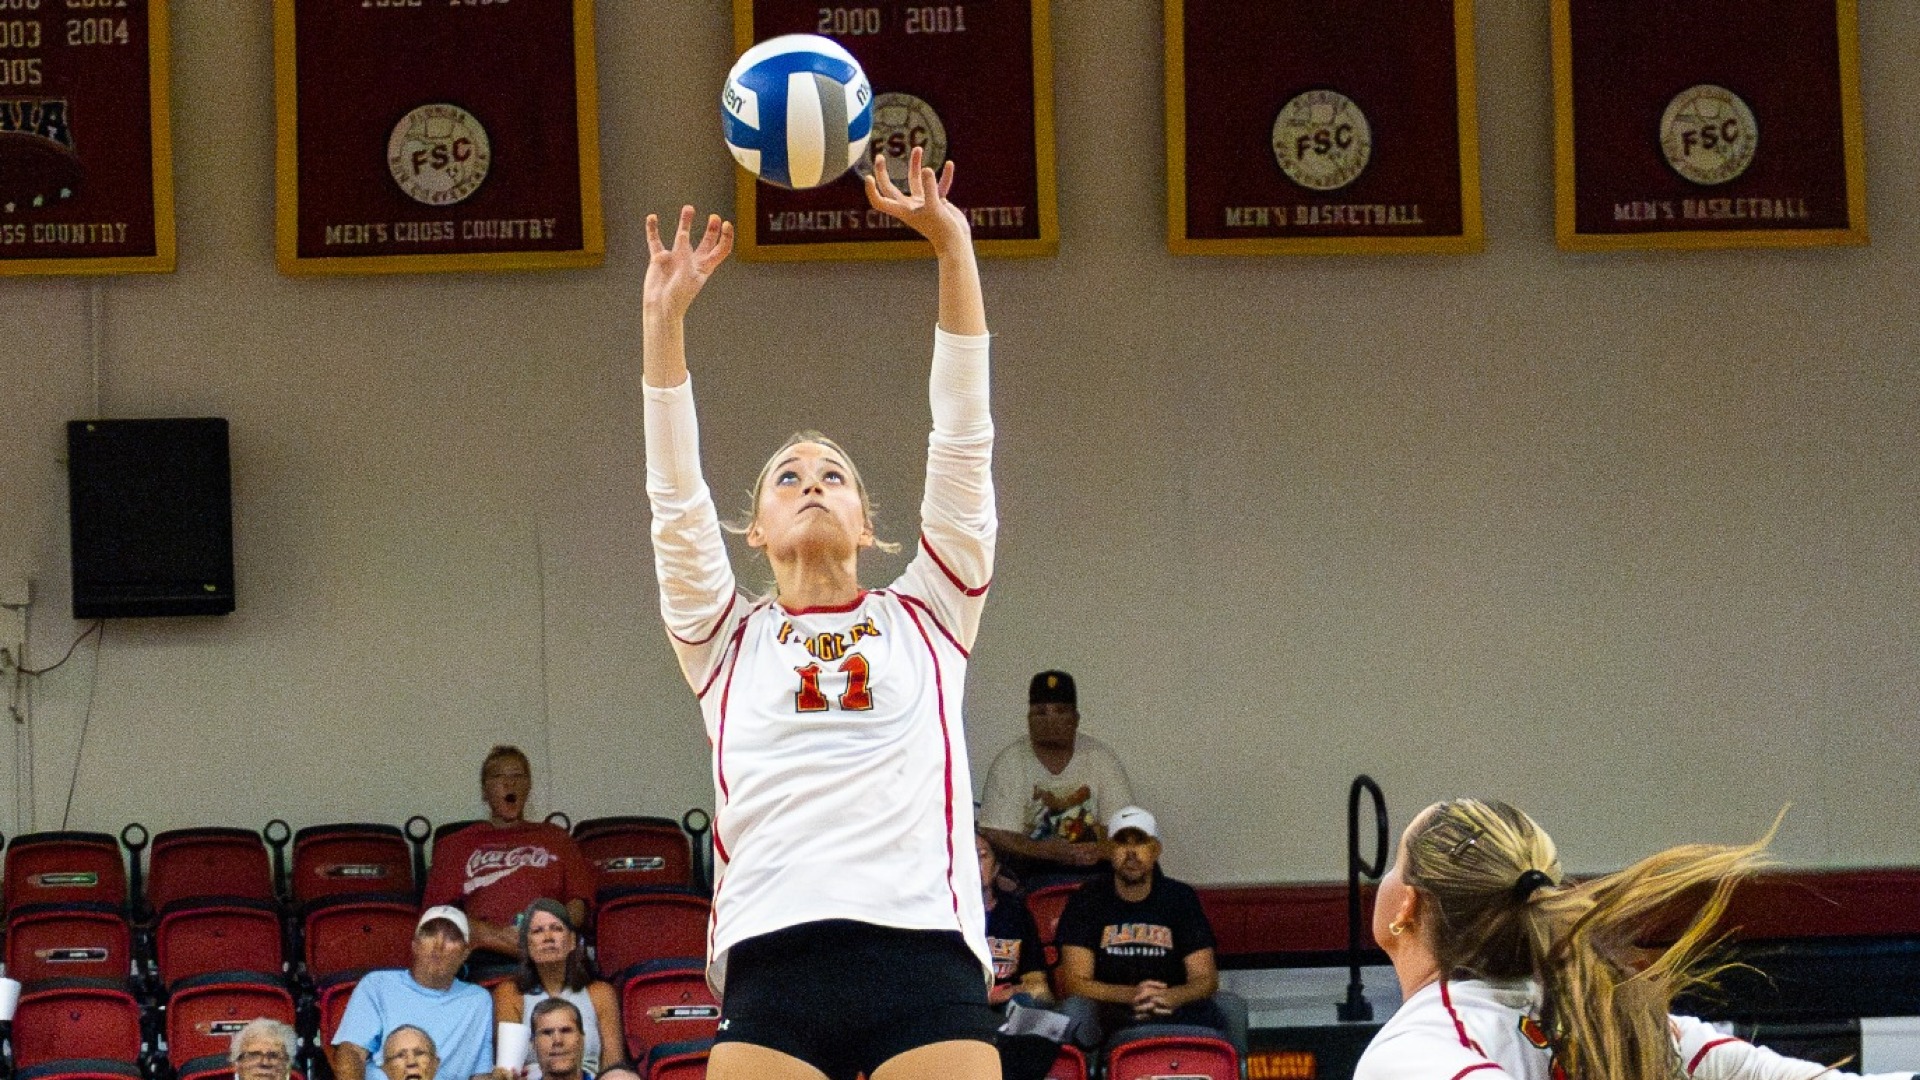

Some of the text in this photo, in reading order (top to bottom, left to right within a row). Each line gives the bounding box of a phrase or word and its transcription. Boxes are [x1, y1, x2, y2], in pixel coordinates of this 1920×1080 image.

[0, 18, 129, 48] 003 2004
[817, 6, 968, 35] 2000 2001
[0, 58, 42, 85] 005
[1296, 123, 1353, 159] FSC
[1681, 118, 1739, 157] FSC
[411, 137, 472, 176] FSC
[33, 222, 128, 244] COUNTRY
[393, 221, 455, 243] CROSS
[462, 217, 557, 240] COUNTRY
